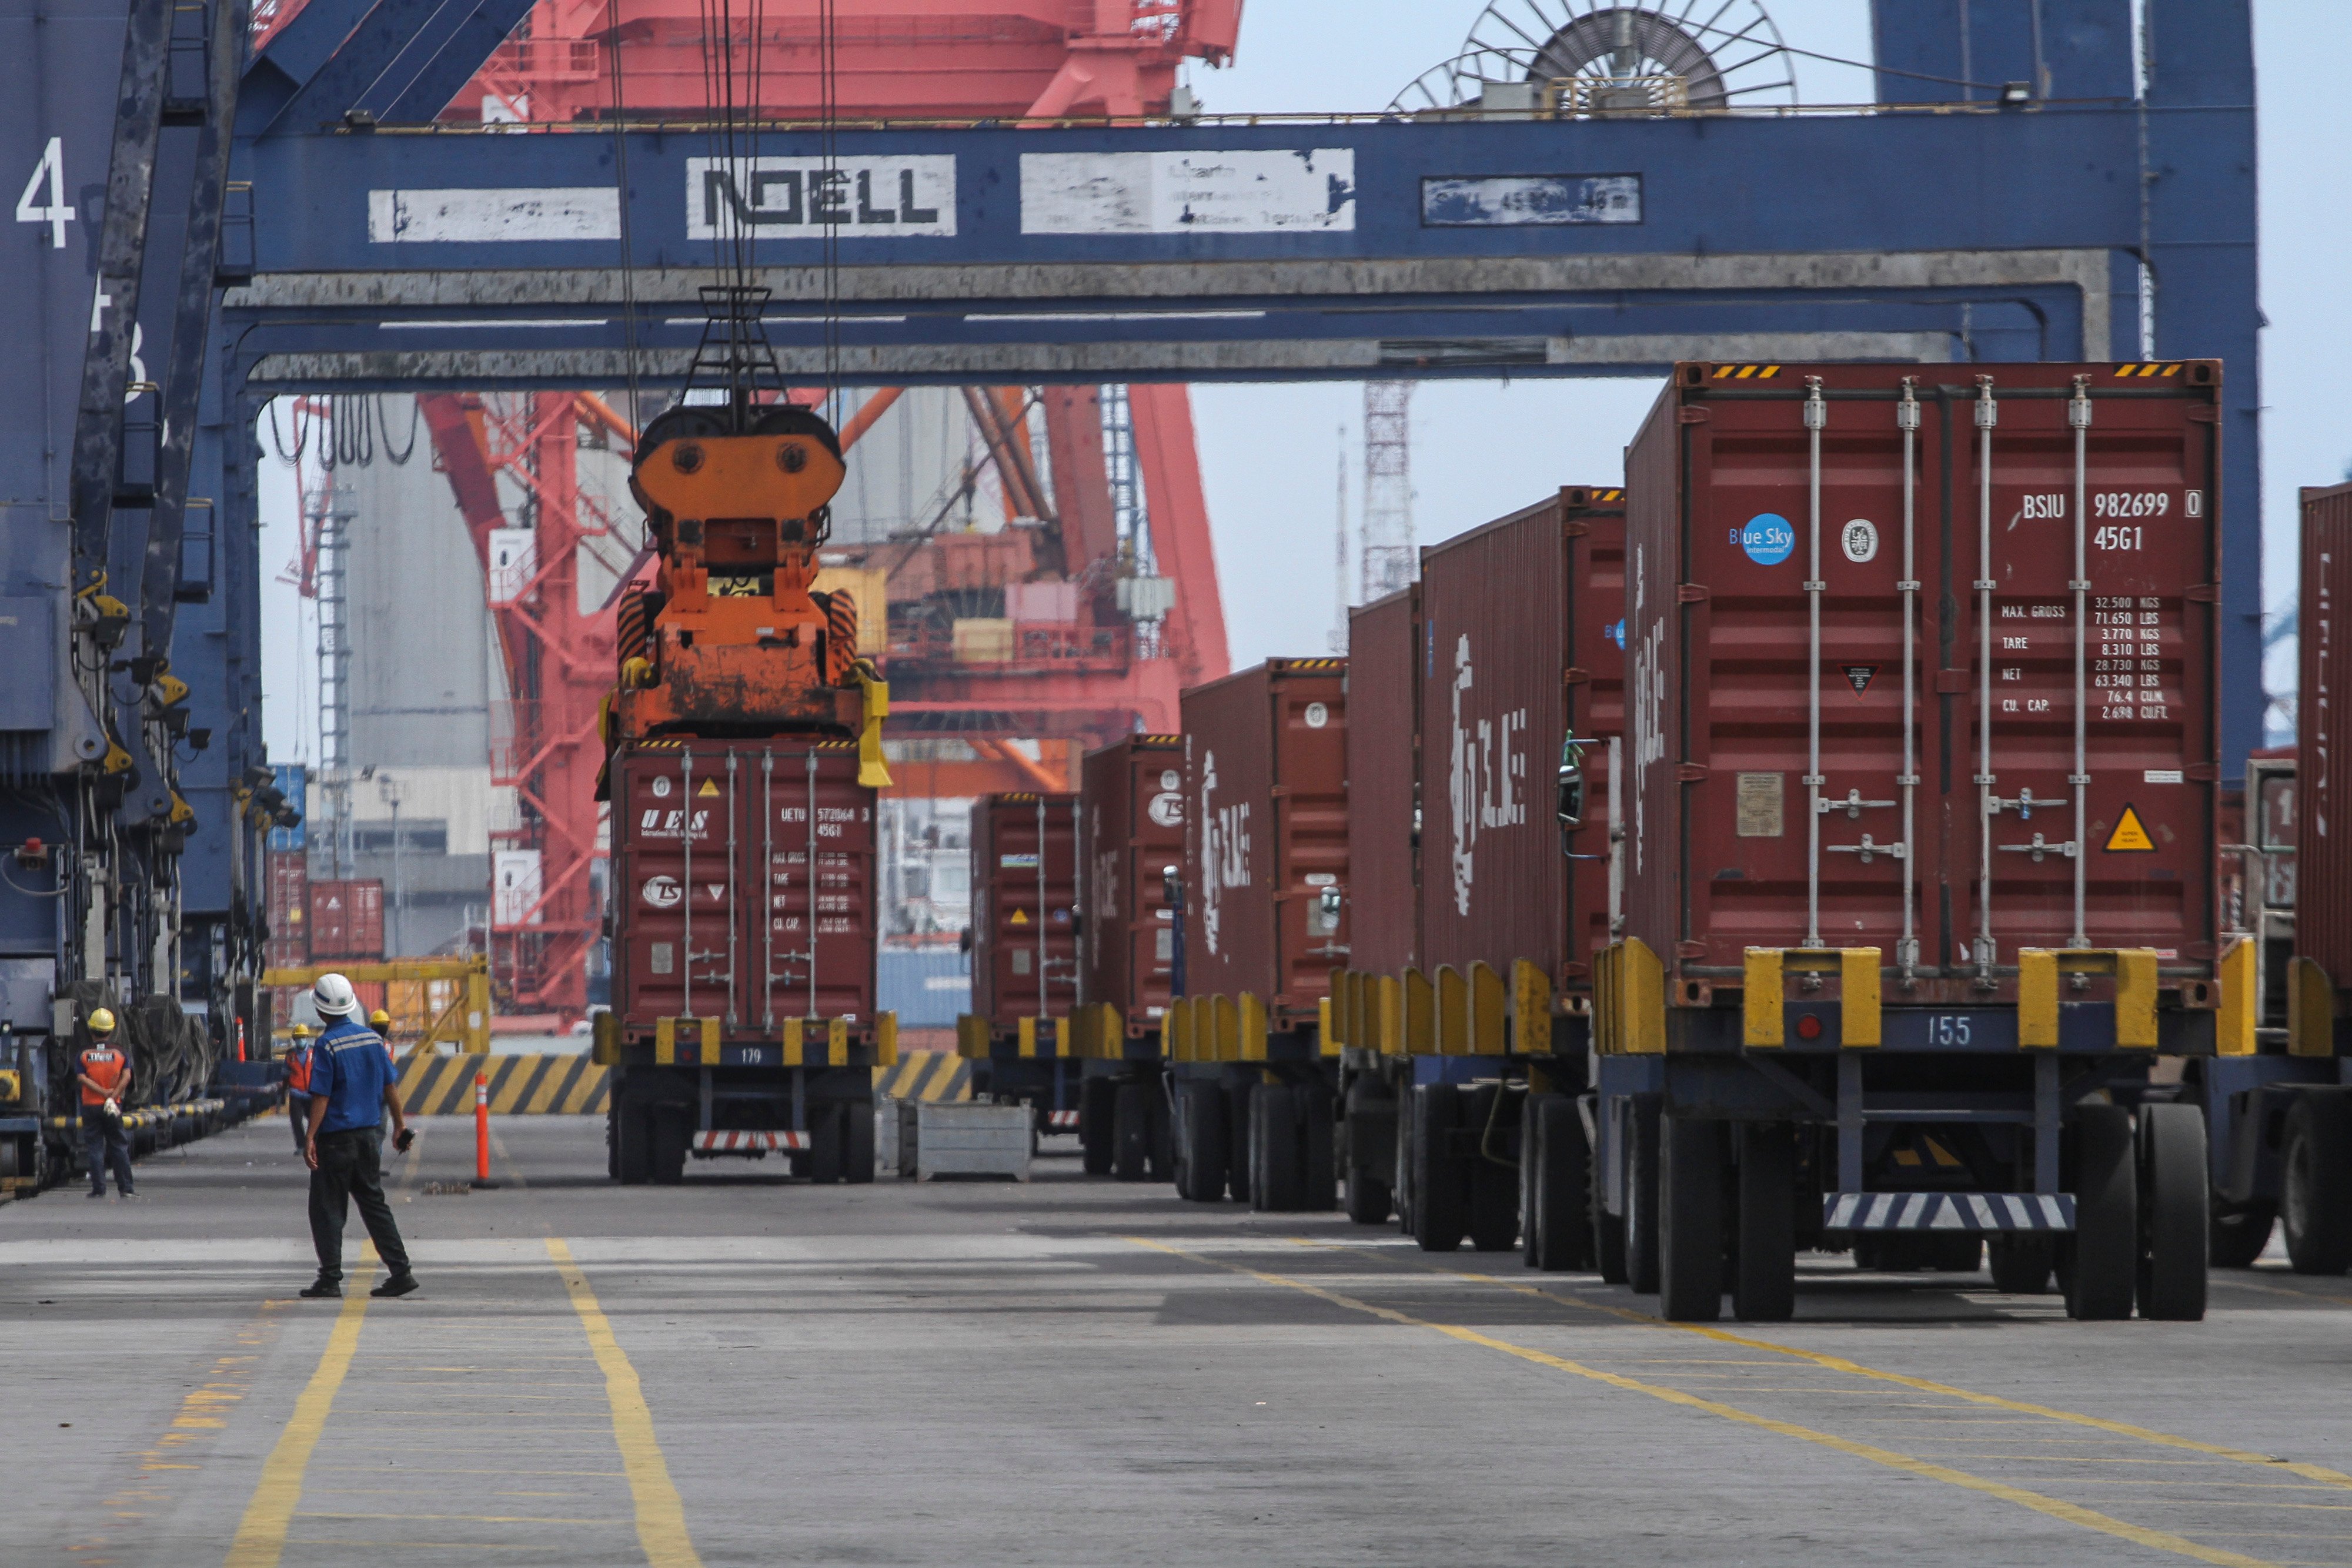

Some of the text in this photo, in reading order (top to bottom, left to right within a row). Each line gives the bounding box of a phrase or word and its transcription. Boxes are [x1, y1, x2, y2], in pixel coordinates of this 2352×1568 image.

[16, 136, 75, 249] 4
[704, 169, 938, 225] NOELL
[2023, 492, 2200, 519] BSIU 982699 0
[1729, 528, 1793, 547] Blue Sky
[2094, 526, 2142, 550] 45G1
[2096, 597, 2160, 608] 32.500 KGS
[2002, 606, 2065, 618] MAX. GROSS
[2095, 612, 2159, 624] 71.650 LBS
[2102, 628, 2160, 640] 3.770 KGS
[2003, 637, 2029, 649] TARE
[2102, 644, 2160, 656] 8.310 LBS
[2096, 660, 2160, 671] 28.730 KGS
[2003, 668, 2021, 680] NET
[2095, 675, 2159, 687] 63.340 LBS
[2107, 691, 2133, 703] 76.4
[2003, 700, 2050, 712] CU. CAP.
[781, 807, 807, 822] UETU
[773, 873, 789, 885] TARE
[773, 895, 786, 908] NET
[1928, 1015, 1971, 1046] 155
